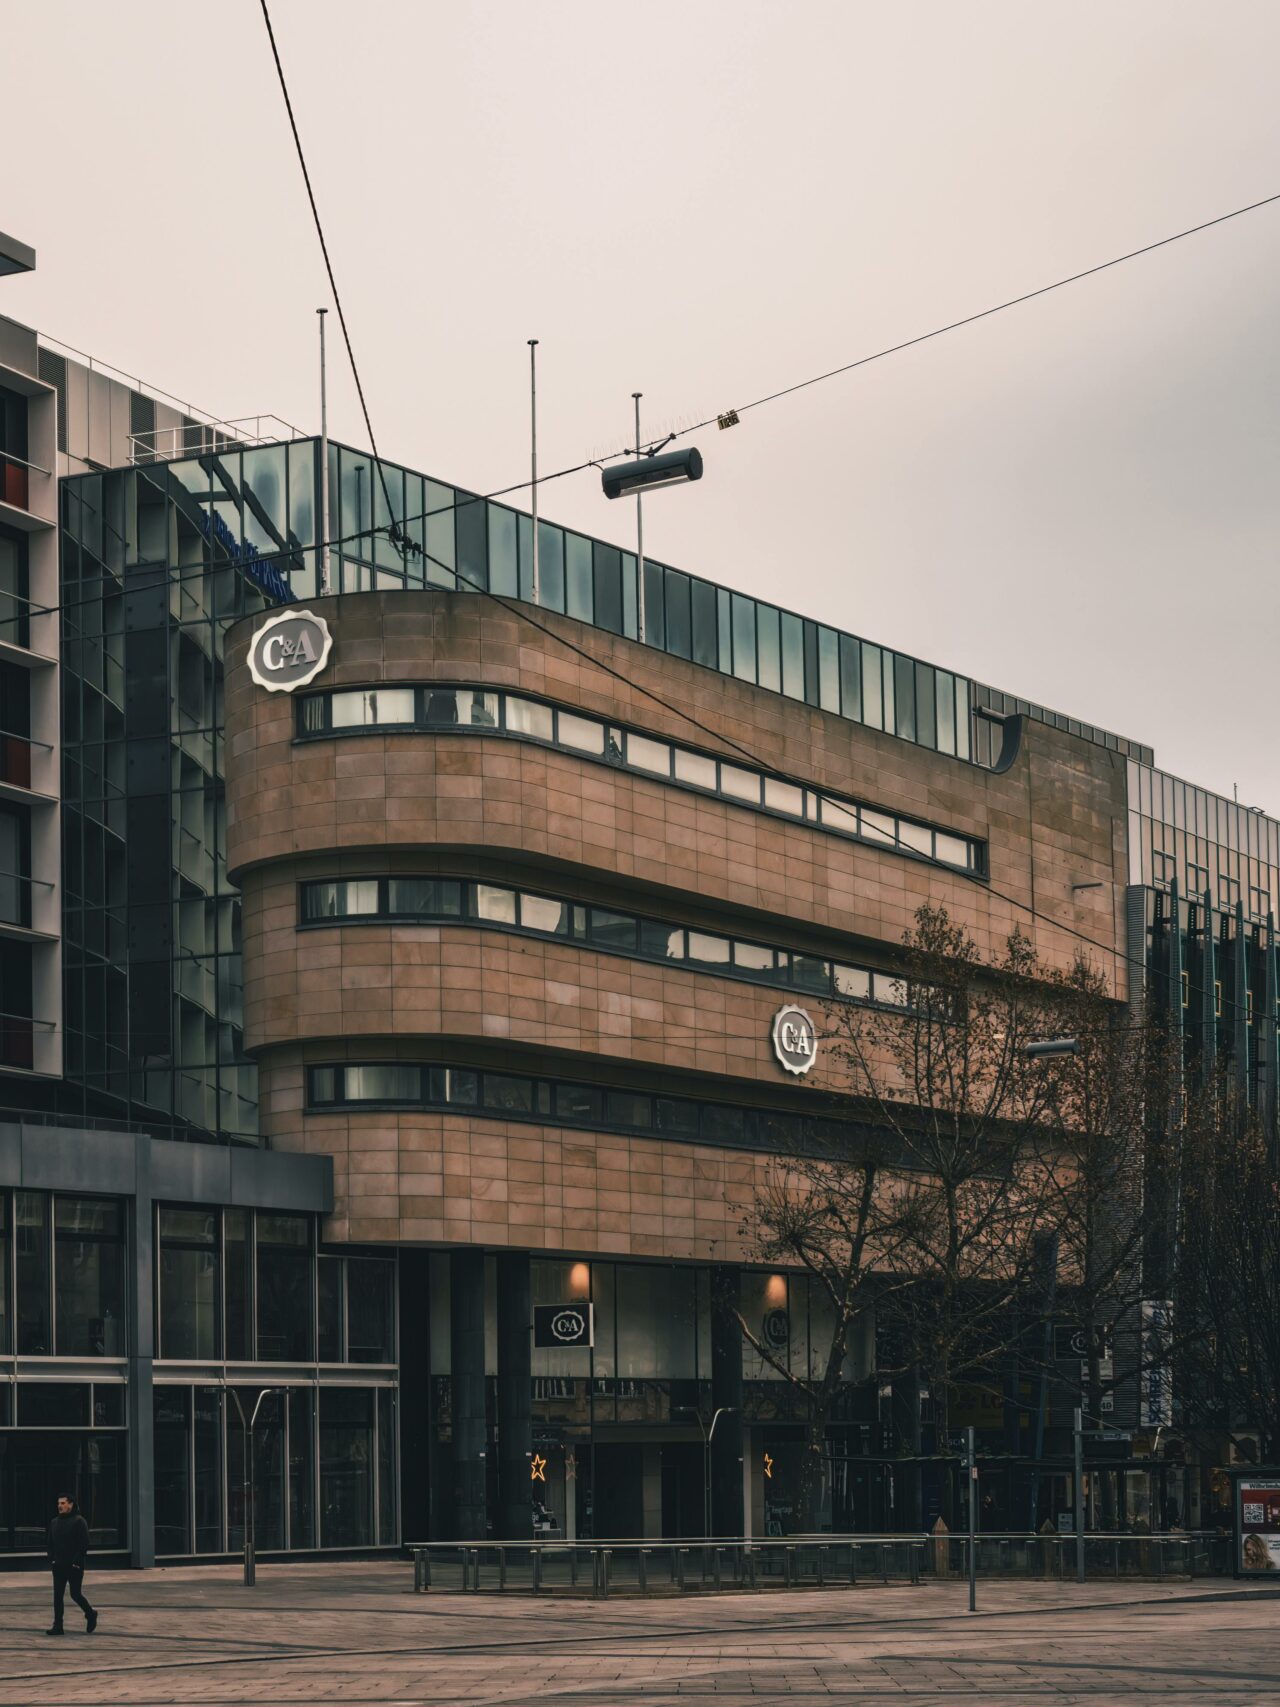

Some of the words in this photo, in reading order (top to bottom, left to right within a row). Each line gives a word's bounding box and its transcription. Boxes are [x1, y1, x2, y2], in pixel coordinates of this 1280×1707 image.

[262, 629, 317, 671] C&A
[781, 1022, 811, 1056] C&A
[557, 1319, 578, 1332] C&A
